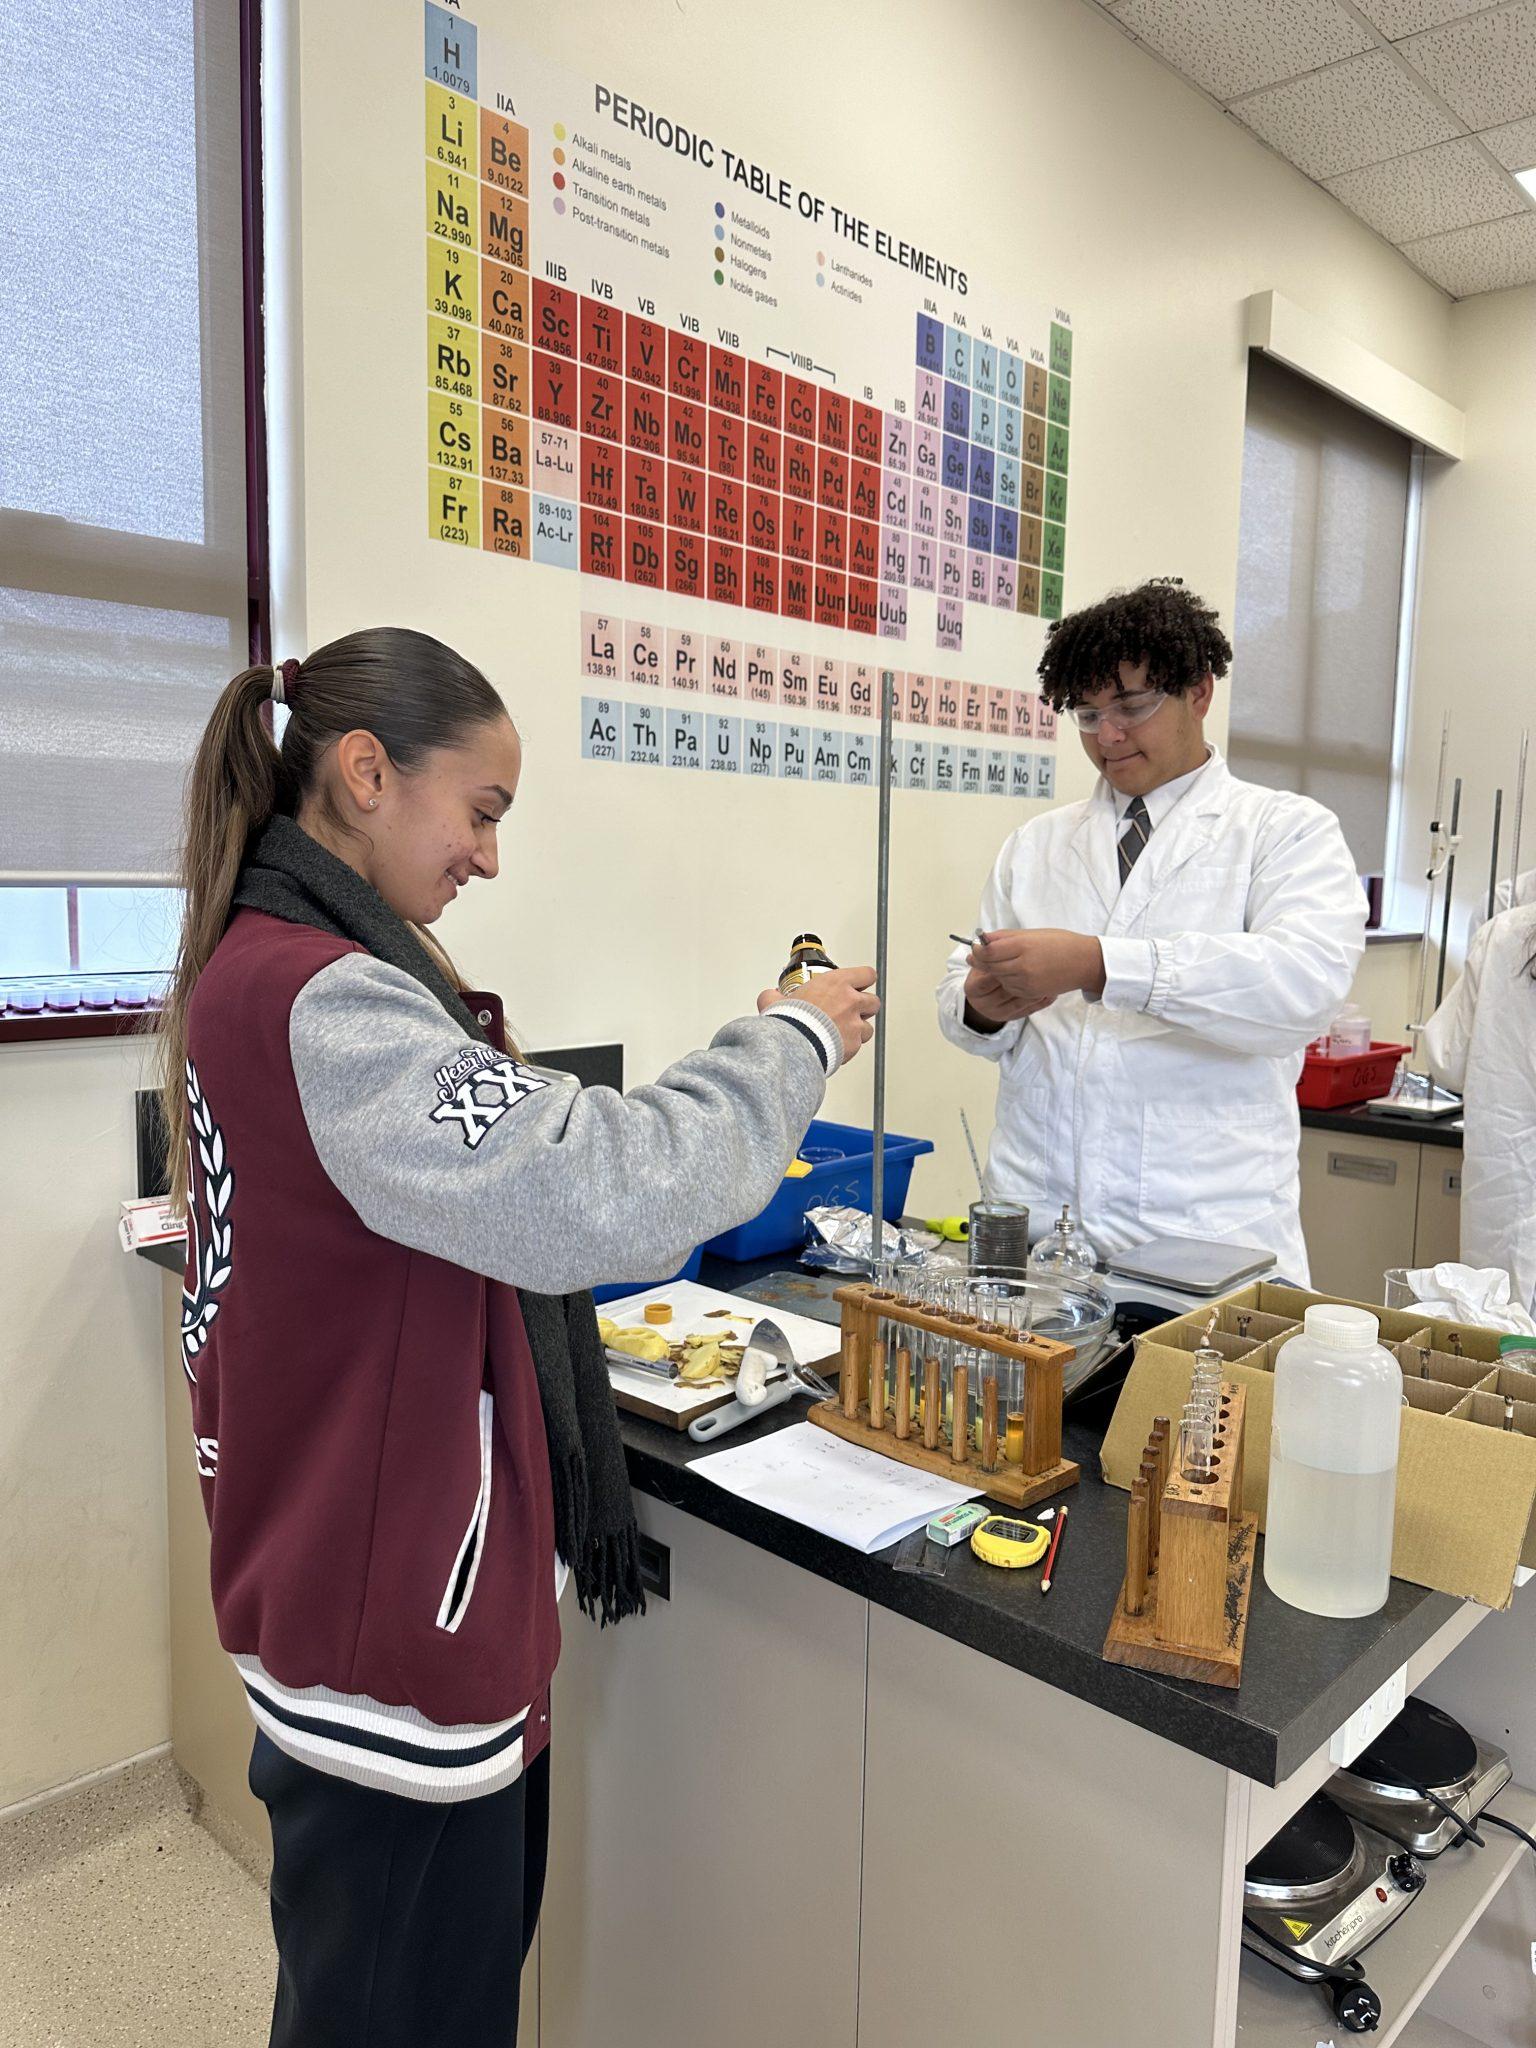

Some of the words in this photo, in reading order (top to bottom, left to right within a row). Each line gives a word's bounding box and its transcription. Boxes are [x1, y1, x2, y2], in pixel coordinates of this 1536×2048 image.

[449, 17, 454, 29] 1
[443, 37, 461, 69] H
[432, 66, 470, 92] 1.0079
[448, 97, 455, 109] 3
[497, 93, 516, 115] IIA
[441, 114, 463, 147] Li
[438, 147, 467, 171] 6.941
[491, 137, 521, 172] Be
[572, 133, 599, 158] Alkali
[601, 149, 631, 171] metals
[448, 174, 459, 188] 11
[487, 168, 523, 194] 9.0122
[572, 158, 609, 184] Alkaline
[612, 179, 635, 196] earth
[637, 188, 667, 212] metals
[595, 84, 713, 168] PERIODIC
[722, 150, 791, 209] TABLE
[798, 192, 824, 223] OF
[831, 207, 869, 248] THE
[876, 230, 968, 296] ELEMENTS
[438, 190, 469, 227] Na
[500, 197, 513, 211] 12
[572, 182, 618, 212] Transition
[621, 206, 651, 227] metals
[434, 221, 471, 246] 22.990
[490, 211, 523, 254] Mg
[572, 207, 639, 244] Post-transition
[641, 236, 670, 258] metals
[731, 211, 770, 239] Metalloids
[447, 249, 459, 264] 19
[730, 233, 772, 262] Nonmetals
[546, 261, 567, 282] IIIB
[731, 255, 767, 280] Halogens
[445, 270, 462, 301] K
[591, 279, 613, 299] IVB
[730, 277, 753, 298] Noble
[755, 291, 777, 308] gases
[831, 281, 862, 303] Actinides
[434, 299, 472, 322] 39.098
[492, 289, 523, 323] Ca
[638, 297, 655, 315] VB
[542, 306, 570, 338] Sc
[680, 313, 700, 333] VIB
[954, 312, 967, 328] IVA
[592, 324, 611, 352] Ti
[718, 328, 739, 348] VIIB
[925, 334, 935, 353] B
[982, 325, 992, 340] VA
[438, 344, 471, 377] Rb
[640, 341, 653, 366] V
[791, 351, 813, 371] VIIIB
[955, 349, 964, 367] C
[1055, 341, 1068, 359] He
[493, 364, 518, 392] Sr
[677, 357, 699, 383] Cr
[981, 359, 989, 378] N
[1006, 371, 1016, 389] O
[435, 376, 472, 397] 85.468
[549, 380, 563, 405] Y
[716, 369, 741, 398] Mn
[864, 386, 873, 399] IB
[591, 394, 613, 421] Zr
[756, 385, 776, 410] Fe
[895, 399, 906, 413] IIB
[922, 391, 935, 412] Al
[634, 408, 660, 436] Nb
[790, 400, 813, 423] Co
[951, 401, 963, 422] Si
[981, 413, 989, 430] P
[675, 420, 701, 448] Mo
[826, 413, 843, 435] Ni
[857, 423, 877, 448] Cu
[1006, 424, 1013, 441] S
[439, 422, 471, 451] Cs
[541, 433, 568, 450] 57-71
[718, 435, 737, 461] Tc
[889, 433, 907, 457] Zn
[437, 451, 473, 472] 132.91
[492, 435, 522, 466] Ba
[753, 447, 776, 473] Ru
[918, 444, 936, 466] Ga
[536, 456, 574, 474] La-Lu
[591, 463, 613, 490] Hf
[789, 459, 811, 484] Rh
[947, 455, 964, 476] Ge
[975, 464, 991, 485] As
[635, 476, 656, 503] Ta
[823, 470, 843, 494] Pd
[1001, 474, 1015, 493] Se
[678, 488, 696, 512] W
[856, 481, 876, 509] Ag
[887, 491, 906, 514] Cd
[442, 495, 468, 523] Fr
[538, 503, 572, 521] 89-103
[716, 498, 738, 523] Re
[920, 501, 932, 521] In
[493, 508, 523, 537] Ra
[537, 522, 573, 543] Ac-Lr
[753, 511, 775, 535] Os
[793, 520, 804, 541] Ir
[945, 511, 962, 531] Sn
[440, 525, 468, 544] (223)
[590, 532, 613, 559] Rf
[824, 530, 840, 552] Pt
[632, 542, 659, 569] Db
[855, 540, 874, 562] Au
[886, 546, 905, 573] Hg
[674, 551, 698, 580] Sg
[714, 563, 737, 588] Bh
[944, 563, 960, 583] Pb
[753, 573, 774, 596] Hs
[788, 580, 807, 601] Mt
[972, 570, 984, 589] Bi
[816, 586, 845, 611] Uun
[848, 597, 877, 618] Uuu
[880, 602, 907, 625] Uub
[591, 634, 614, 660] La
[633, 644, 658, 667] Ce
[587, 663, 616, 677] 138.91
[676, 650, 696, 673] Pr
[713, 656, 736, 679] Nd
[748, 663, 773, 685] Pm
[783, 669, 807, 692] Sm
[819, 675, 837, 696] Eu
[851, 682, 870, 702] Gd
[911, 691, 928, 714] Dy
[940, 695, 956, 713] Ho
[967, 699, 980, 717] Er
[990, 702, 1007, 721] Tm
[1016, 706, 1030, 724] Yb
[1040, 710, 1053, 726] Lu
[590, 719, 616, 742] Ac
[633, 724, 656, 747] Th
[675, 729, 697, 751] Pa
[718, 735, 729, 755] U
[750, 738, 771, 765] Np
[785, 743, 804, 763] Pu
[815, 747, 839, 768] Am
[848, 751, 870, 771] Cm
[910, 757, 925, 774] Cf
[938, 760, 953, 778] Es
[962, 762, 980, 780] Fm
[161, 1221, 184, 1231] Cling
[1323, 1914, 1363, 1949] kitchenpro
